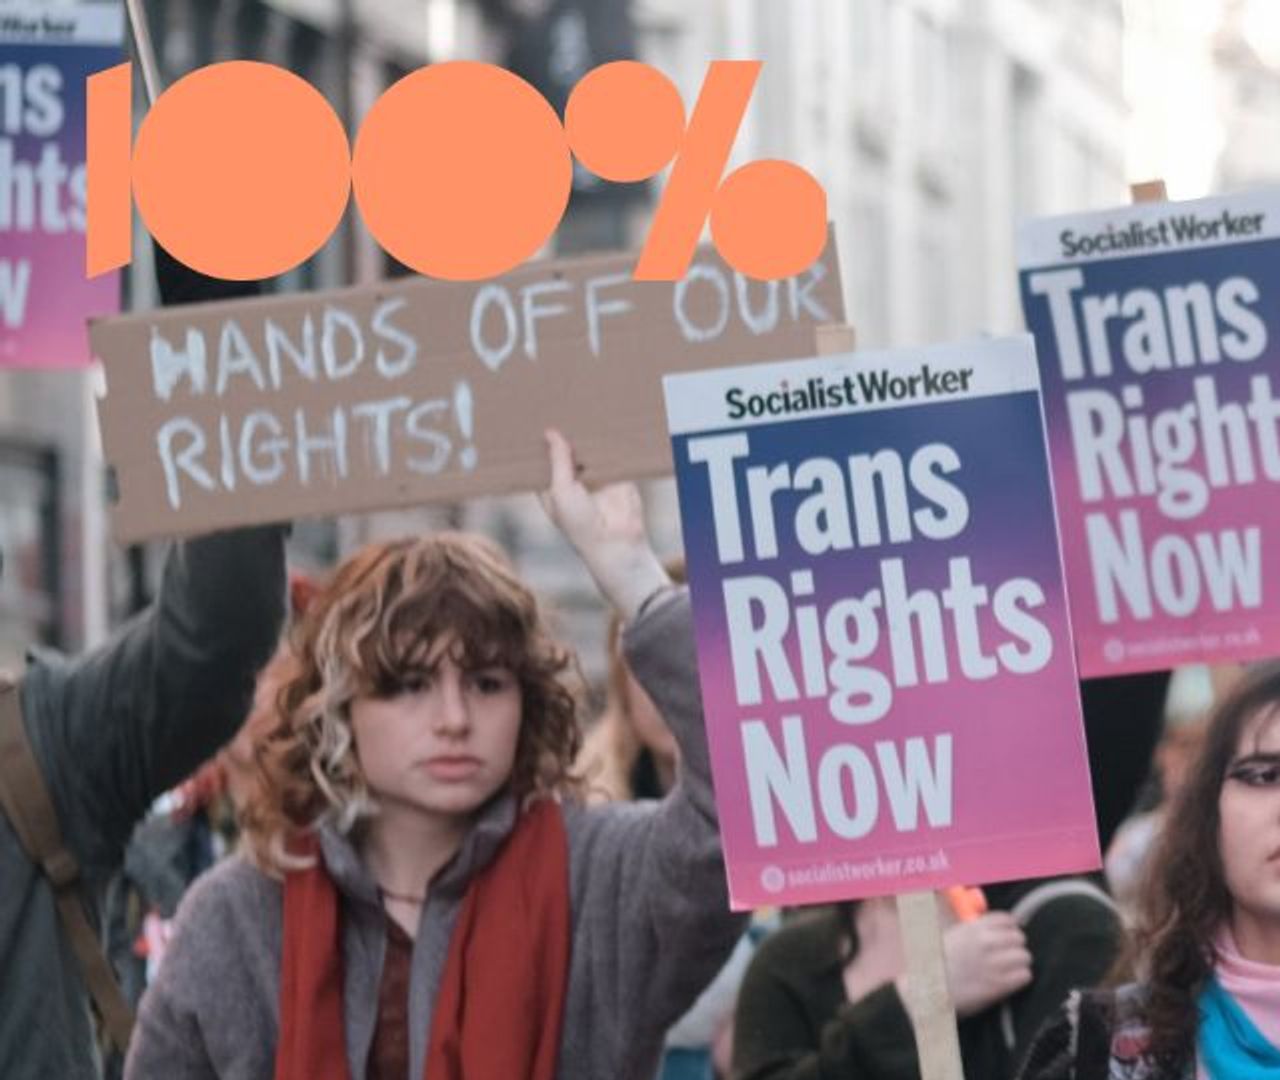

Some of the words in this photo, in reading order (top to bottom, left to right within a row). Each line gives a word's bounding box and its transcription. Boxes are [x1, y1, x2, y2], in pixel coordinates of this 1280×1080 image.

[150, 295, 418, 399] HANDS
[469, 271, 636, 372] OFF
[1029, 268, 1267, 380] Trans
[156, 380, 478, 510] RIGHTS!
[687, 432, 969, 564] Trans
[1085, 510, 1262, 623] Now
[722, 557, 1053, 725] Rights
[740, 716, 952, 847] Now
[788, 848, 948, 887] socialistworker.co.uk
